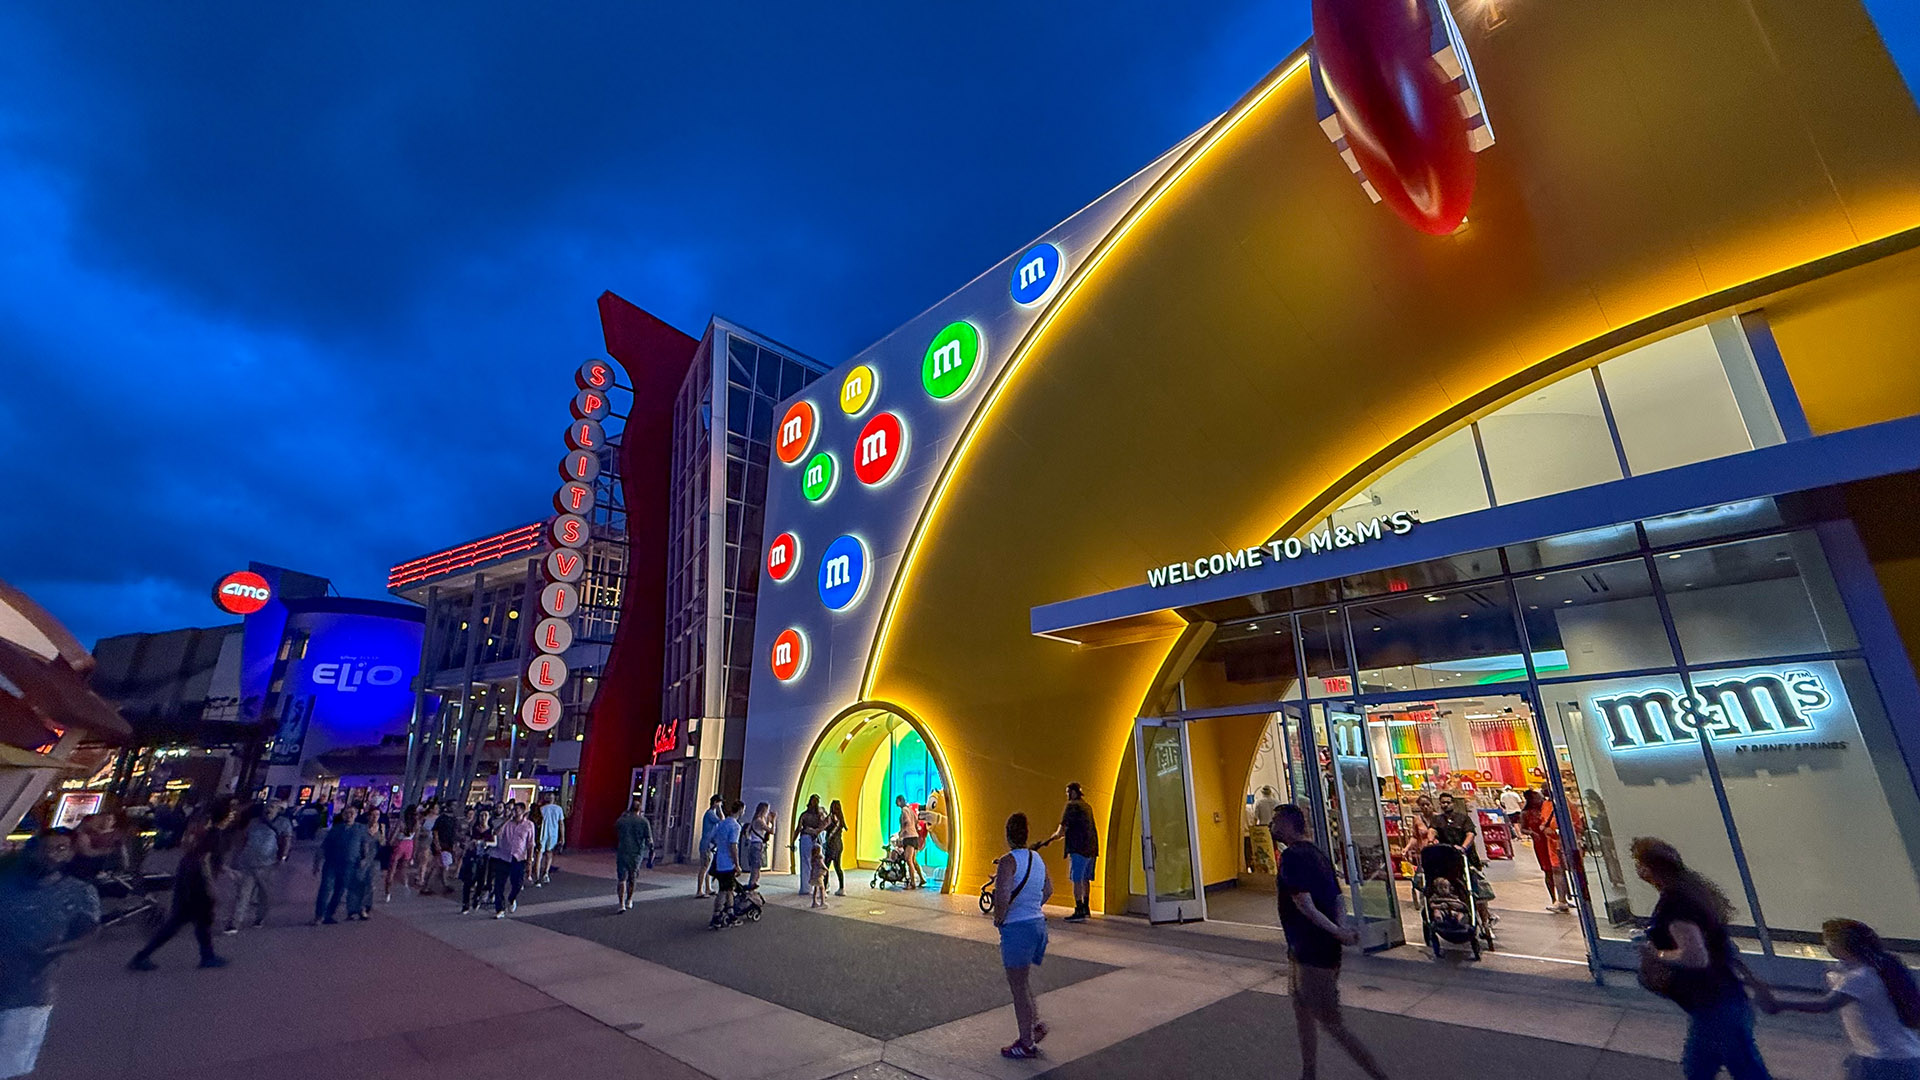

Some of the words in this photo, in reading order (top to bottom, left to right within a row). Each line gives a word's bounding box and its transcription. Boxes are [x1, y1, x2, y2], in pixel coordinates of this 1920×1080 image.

[1019, 256, 1046, 290] m
[933, 339, 963, 380] m
[845, 377, 863, 402] m
[782, 415, 803, 448] m
[862, 429, 887, 467] m
[807, 464, 823, 488] m
[532, 364, 606, 725] SPLITSVILLE
[770, 544, 786, 568] m
[825, 554, 851, 590] m
[1147, 546, 1263, 589] WELCOME
[1268, 537, 1302, 562] TO
[776, 642, 792, 667] m
[1735, 744, 1748, 753] AT
[1751, 742, 1792, 753] DISNEY
[1795, 740, 1848, 751] SPRINGS
